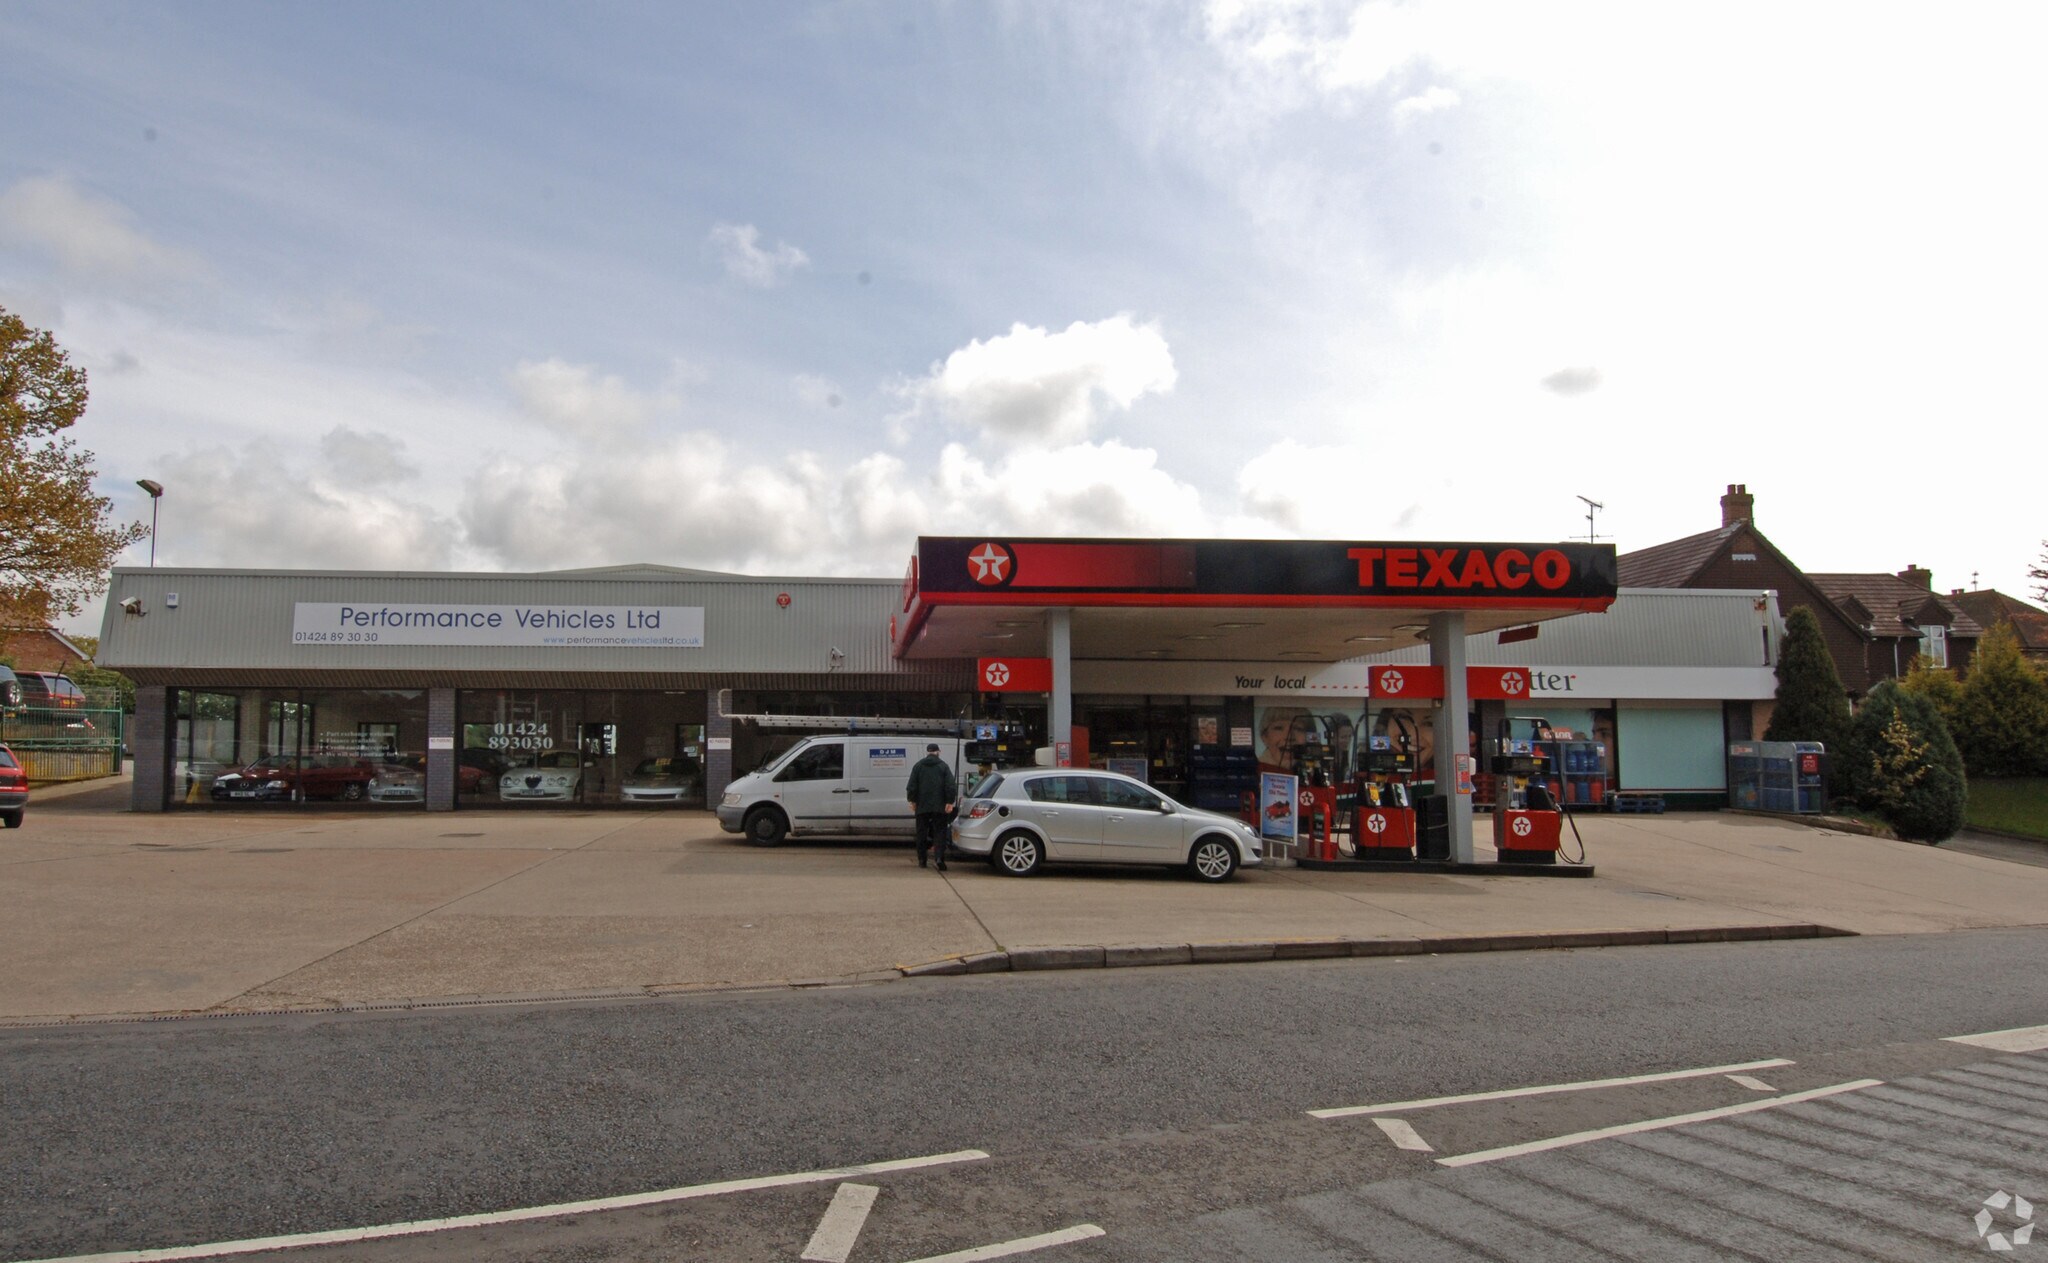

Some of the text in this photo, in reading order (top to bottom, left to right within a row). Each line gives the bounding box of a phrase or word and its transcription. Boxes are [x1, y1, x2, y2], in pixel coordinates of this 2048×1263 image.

[1347, 548, 1571, 590] TEXACO
[340, 607, 661, 629] Performance Vehicles Ltd
[295, 632, 379, 642] 01424 89 30 30
[1235, 671, 1576, 691] Your local tter
[494, 723, 548, 735] 01424
[488, 737, 554, 749] 893030
